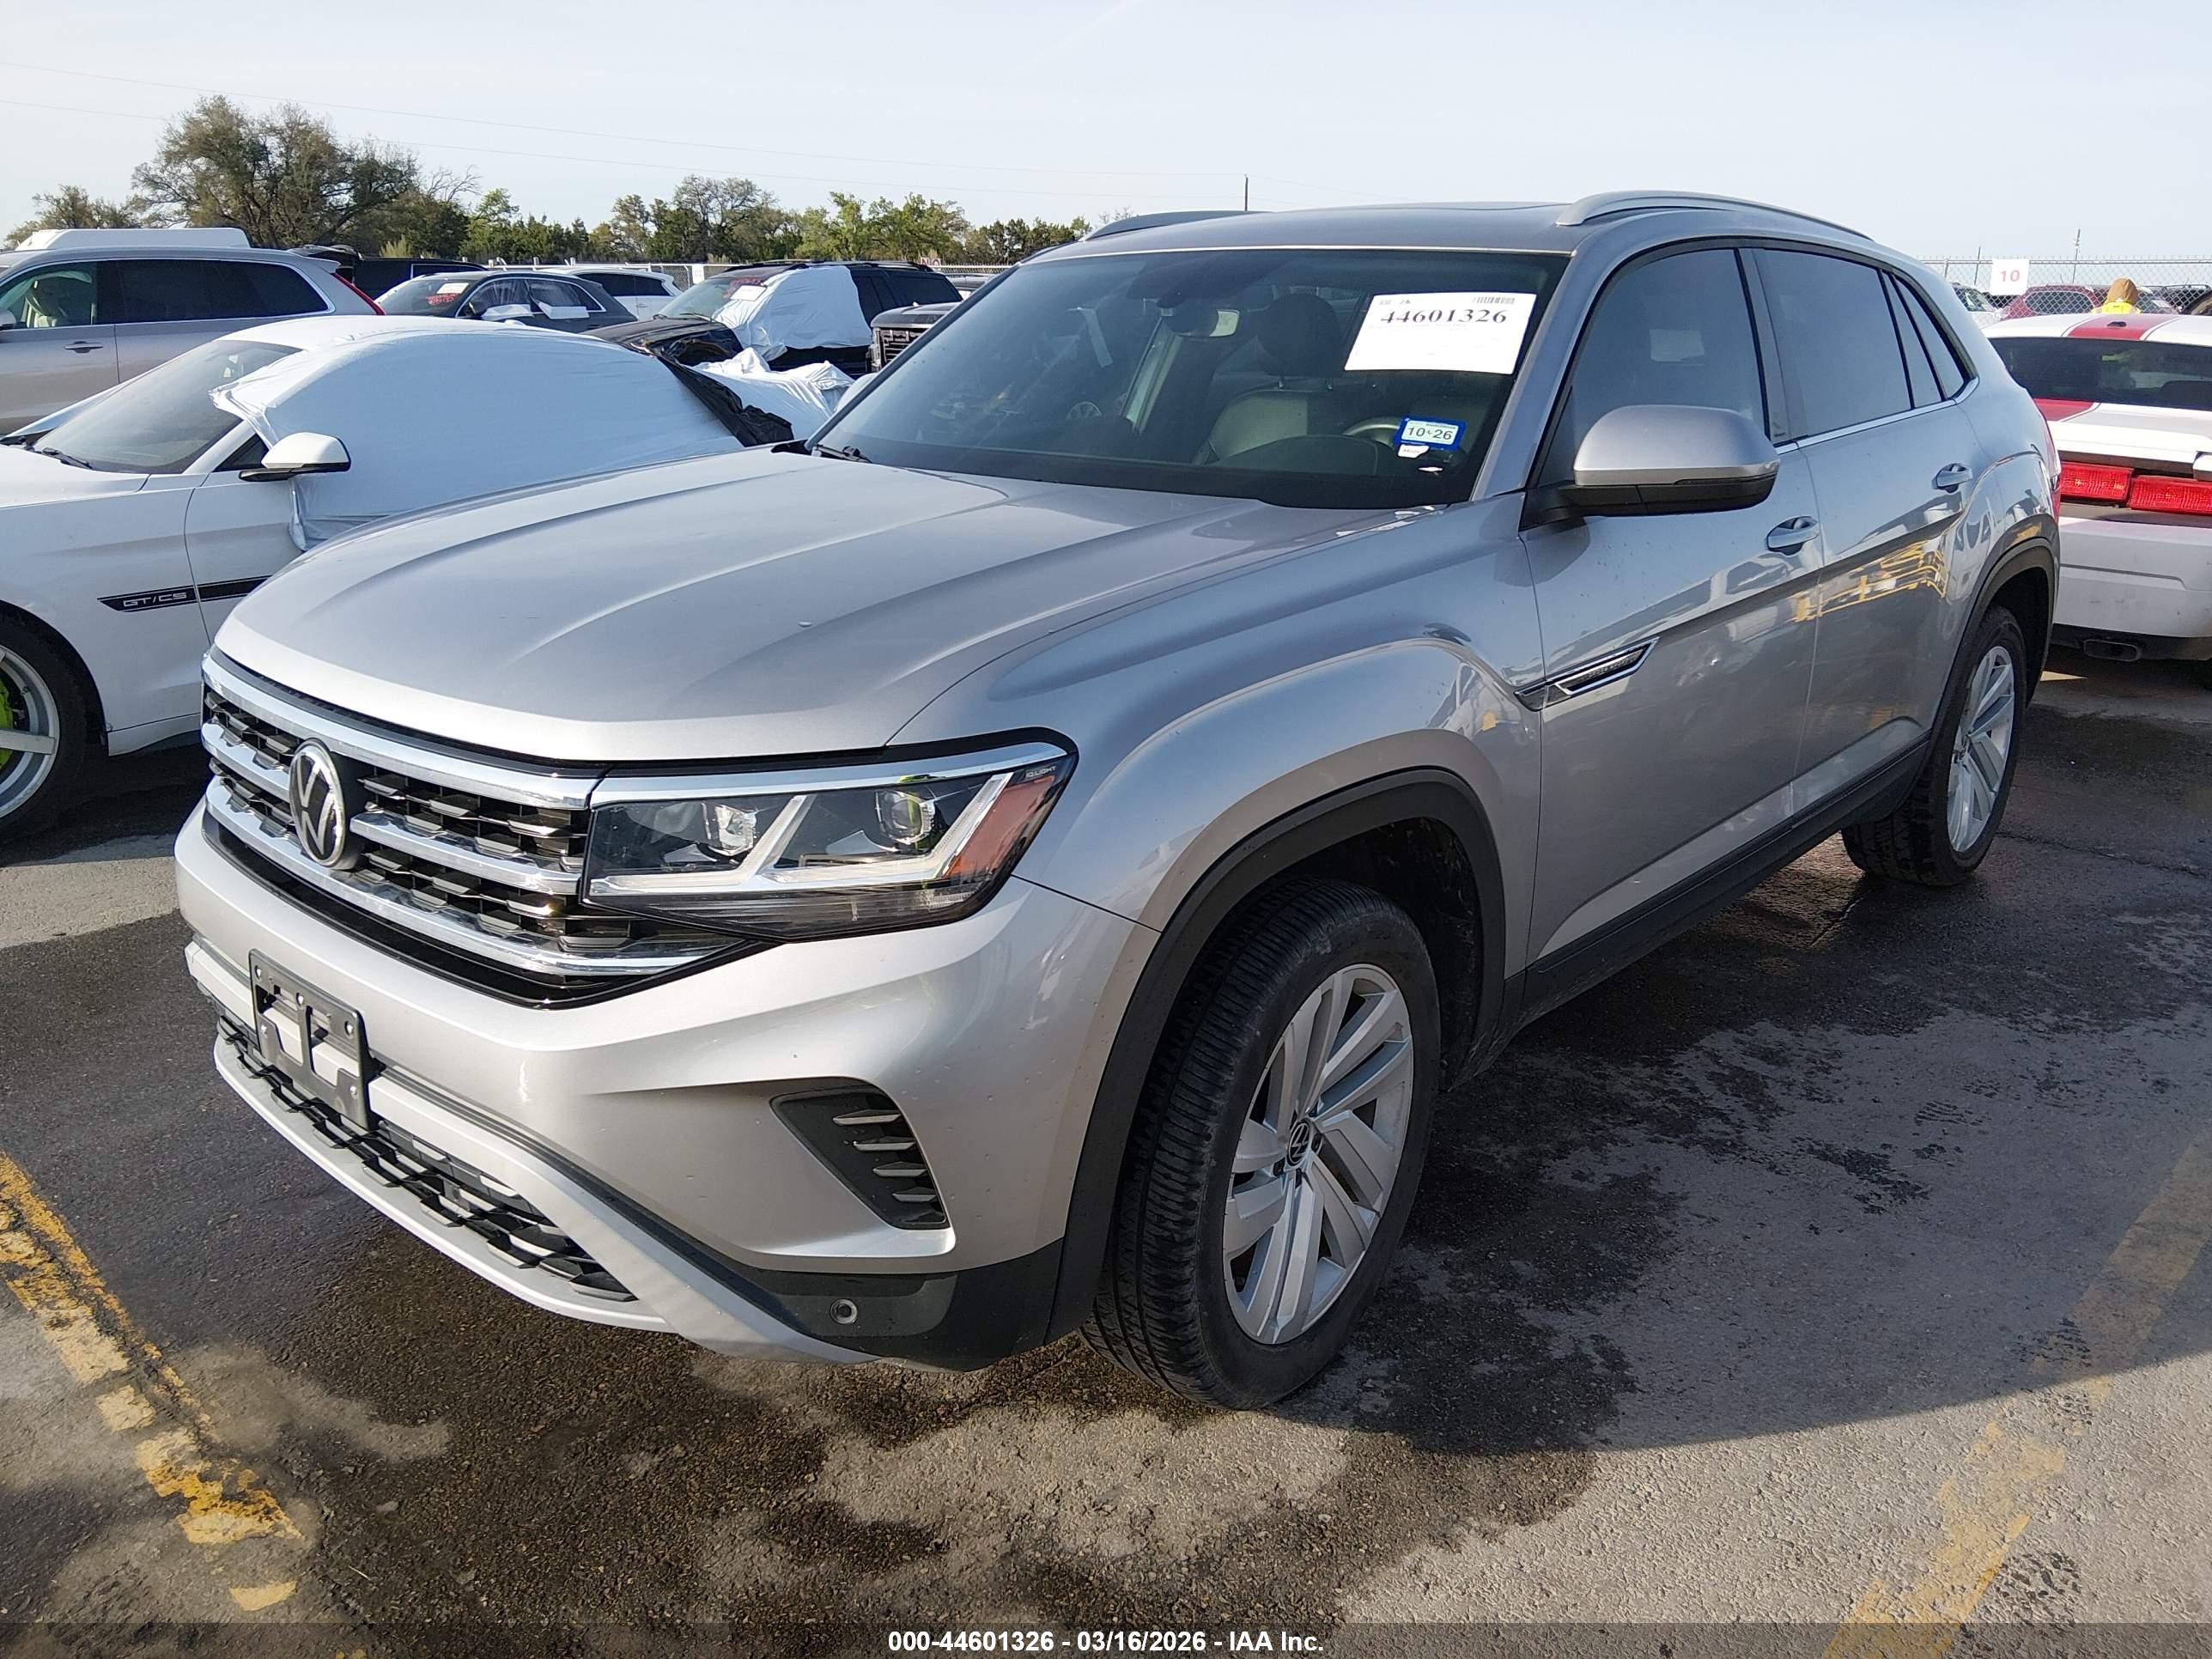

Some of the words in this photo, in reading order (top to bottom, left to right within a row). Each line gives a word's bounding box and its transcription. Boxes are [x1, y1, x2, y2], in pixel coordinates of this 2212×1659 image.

[2000, 270, 2021, 282] 10
[1381, 309, 1509, 323] 44601326
[1407, 427, 1425, 437] 10
[1433, 429, 1453, 441] 26
[123, 592, 187, 607] GT/CS
